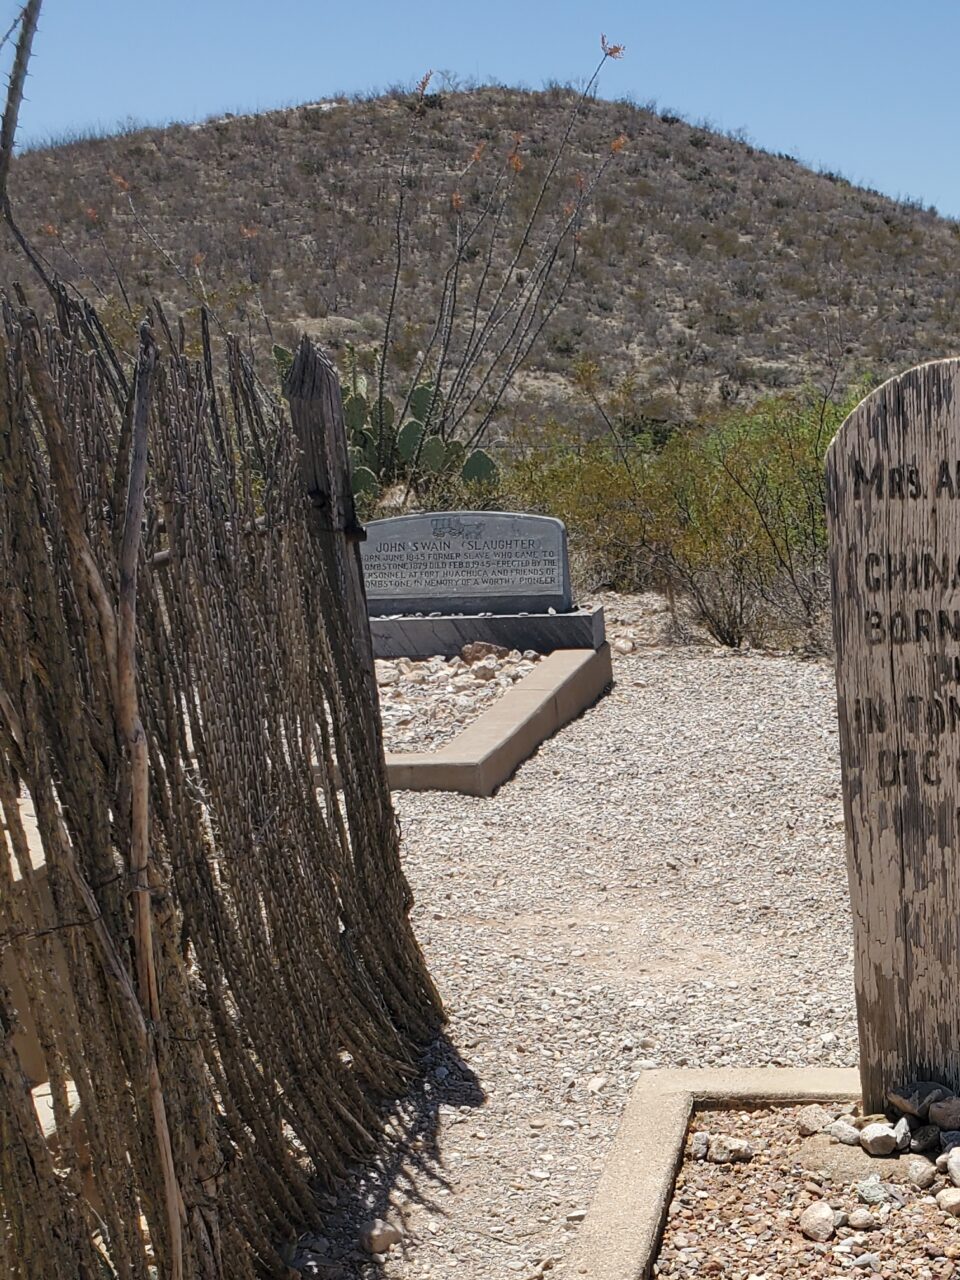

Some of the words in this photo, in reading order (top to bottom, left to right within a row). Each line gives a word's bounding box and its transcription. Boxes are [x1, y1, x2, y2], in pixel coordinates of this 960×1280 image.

[376, 542, 406, 553] JOHN
[411, 540, 451, 552] SWAIN
[428, 552, 460, 560] FORMER
[464, 551, 489, 560] SLAVE
[493, 551, 512, 559] WHO
[515, 550, 538, 559] CAME
[542, 550, 554, 558] TO
[364, 563, 408, 571] OMBSTONE
[429, 561, 446, 569] DIED
[531, 559, 540, 567] BY
[543, 559, 557, 567] THE
[363, 571, 406, 579] RSONNEL
[420, 570, 440, 578] FORT
[491, 569, 508, 577] AND
[510, 568, 544, 576] FRIENDS
[545, 568, 555, 576] OF
[365, 580, 412, 588] OMBSTONE
[424, 579, 460, 588] MEMORY
[461, 578, 472, 586] OF
[472, 578, 480, 586] A
[519, 576, 556, 585] PIONEER
[855, 697, 886, 734] IN
